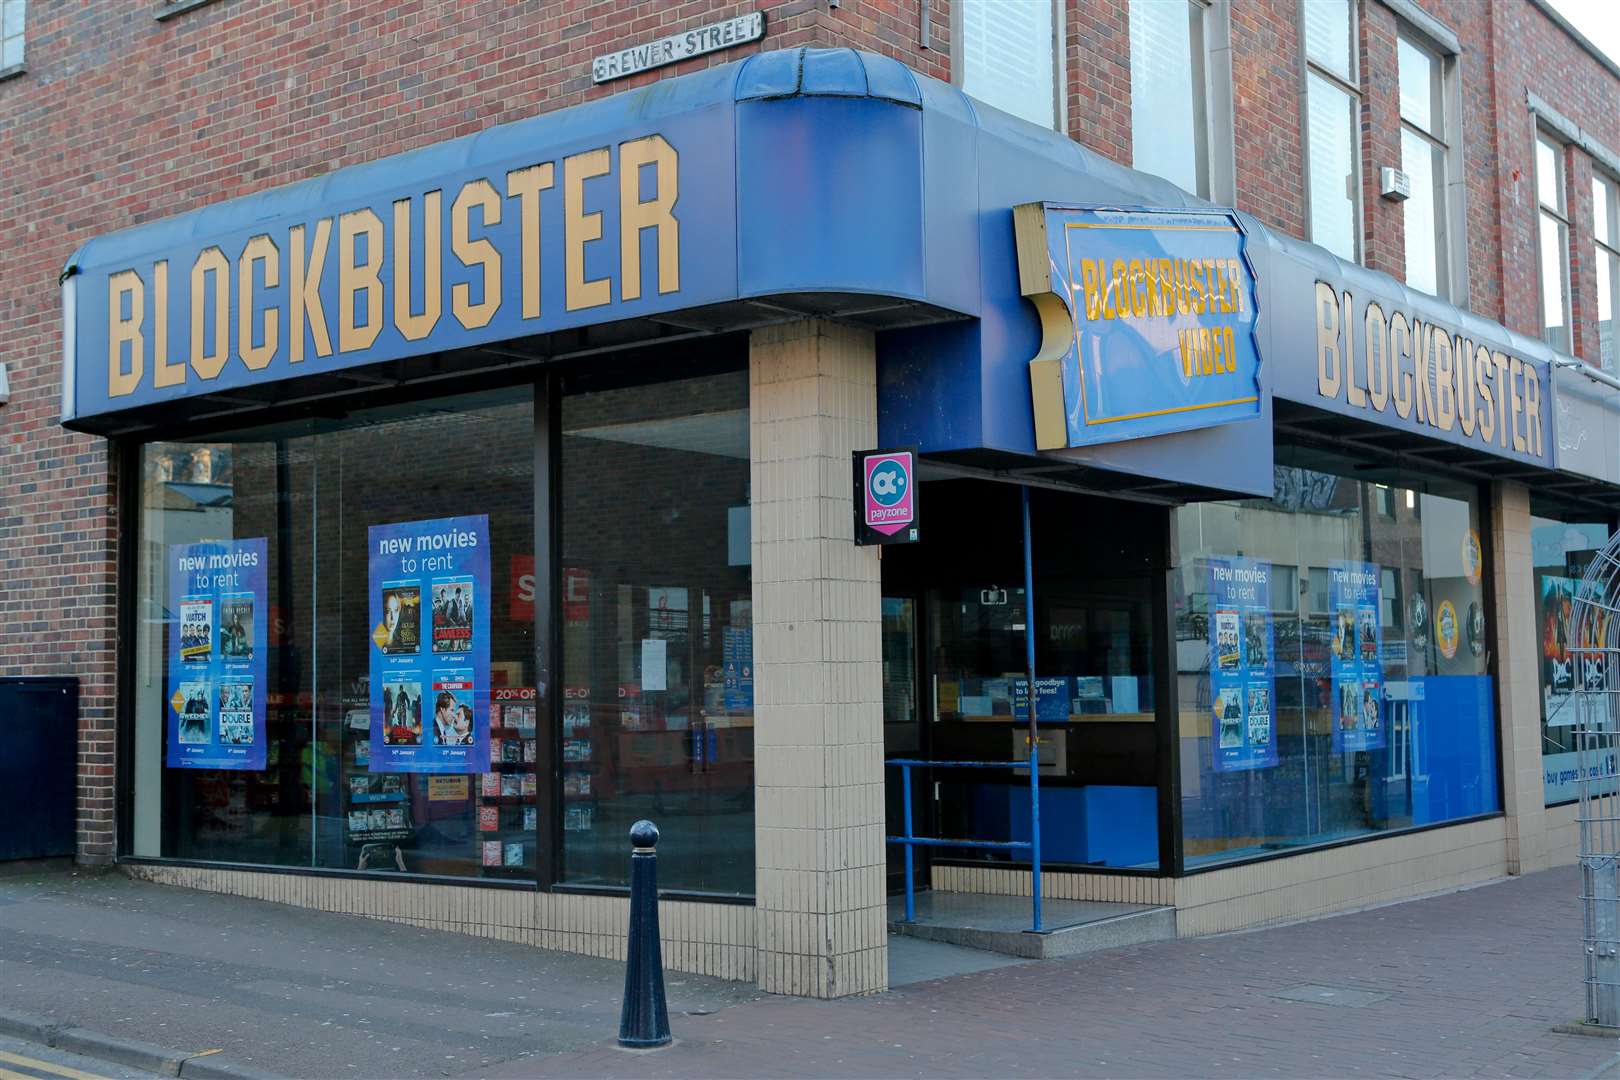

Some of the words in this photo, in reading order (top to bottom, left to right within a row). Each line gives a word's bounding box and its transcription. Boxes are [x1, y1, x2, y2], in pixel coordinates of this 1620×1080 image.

[594, 40, 674, 80] BREWER
[684, 15, 760, 54] STREET
[108, 133, 680, 398] BLOCKBUSTER
[1081, 258, 1244, 321] BLOCKBUSTER
[1178, 325, 1237, 378] VIDEO
[1315, 279, 1543, 457] BLOCKBUSTER
[871, 507, 909, 521] payzone
[380, 537, 412, 555] new
[417, 528, 478, 551] movies
[179, 555, 206, 571] new
[209, 549, 258, 569] movies
[402, 556, 417, 573] to
[421, 552, 453, 572] rent
[196, 574, 209, 589] to
[213, 570, 239, 588] rent
[1213, 567, 1233, 581] new
[1235, 566, 1267, 584] movies
[1333, 570, 1349, 583] new
[1350, 570, 1376, 586] movies
[1227, 585, 1236, 599] to
[1238, 586, 1255, 601] rent
[1344, 587, 1352, 600] to
[1353, 588, 1367, 601] rent
[185, 612, 207, 622] WATCH
[433, 628, 471, 640] LAWLESS
[1035, 678, 1065, 688] goodbye
[1040, 687, 1057, 695] fees!
[496, 689, 518, 700] 20%
[222, 713, 251, 724] DOUBLE
[1546, 770, 1559, 786] buy
[1559, 767, 1579, 786] games
